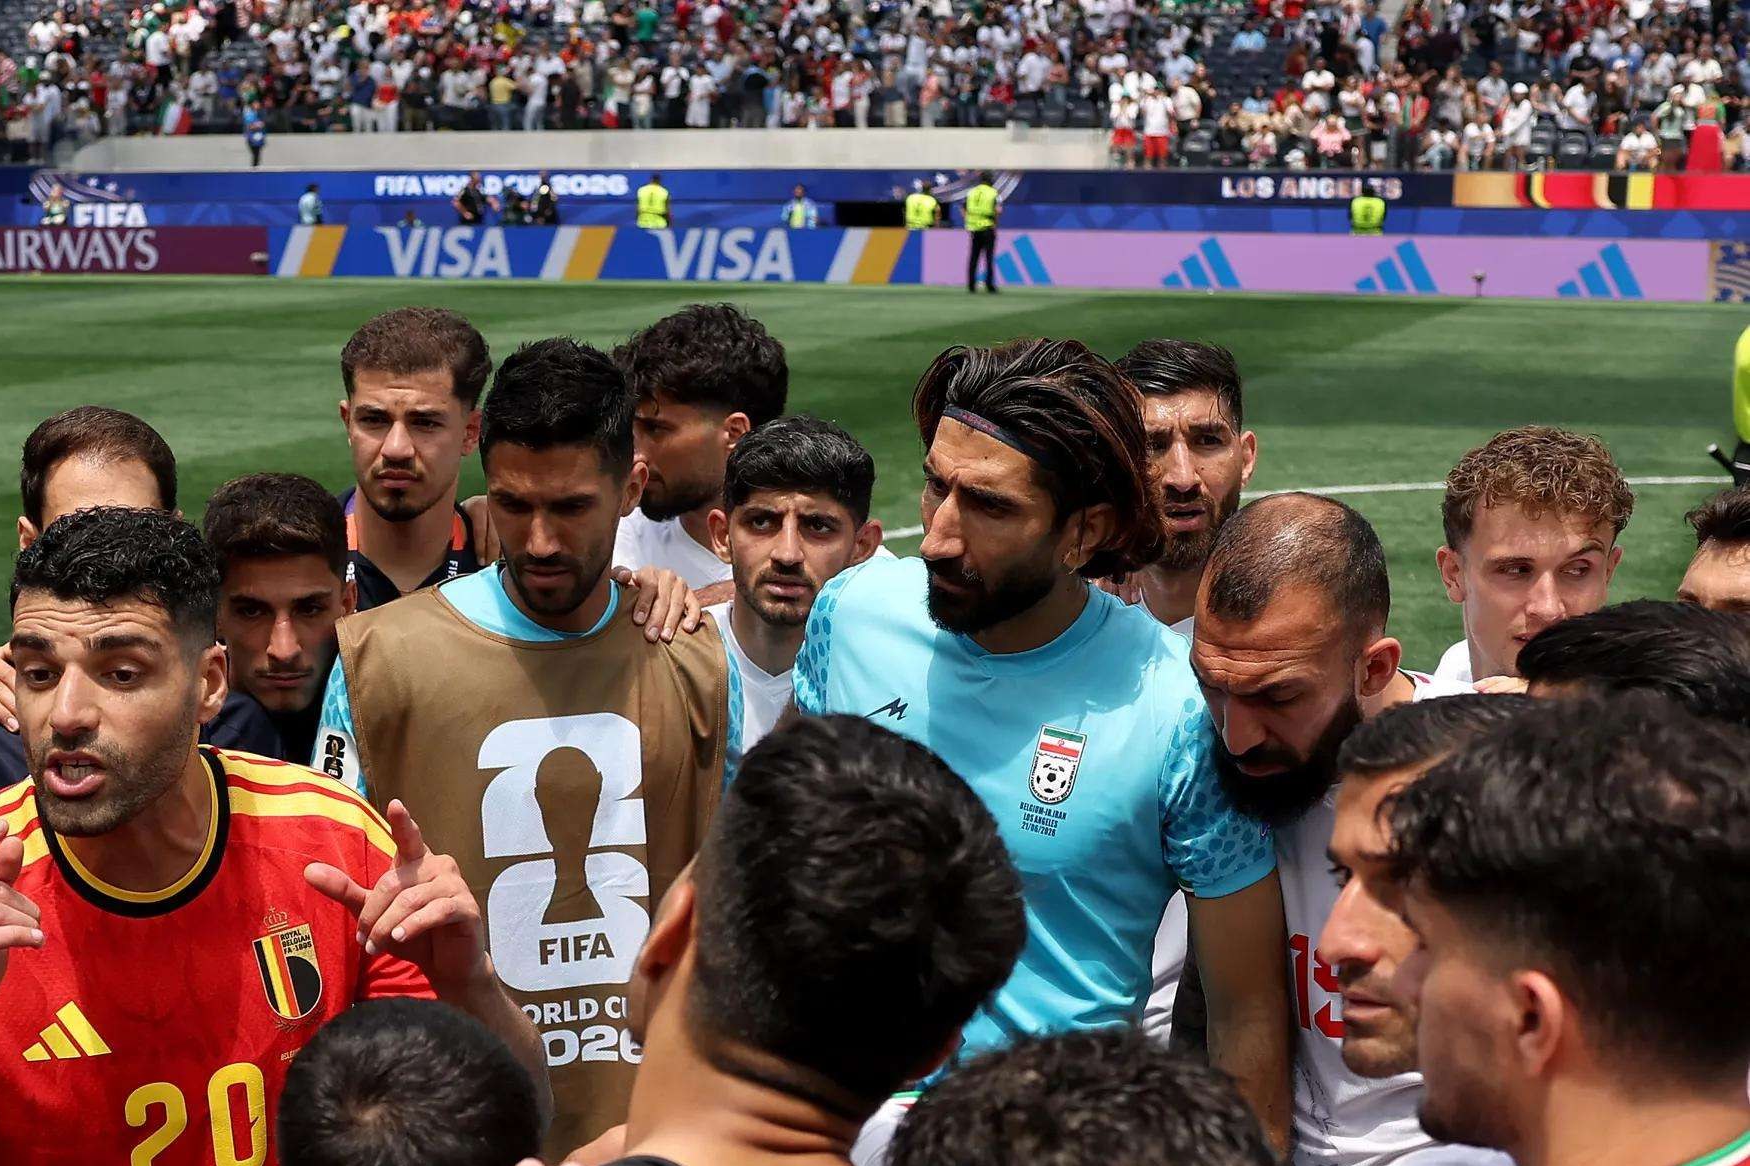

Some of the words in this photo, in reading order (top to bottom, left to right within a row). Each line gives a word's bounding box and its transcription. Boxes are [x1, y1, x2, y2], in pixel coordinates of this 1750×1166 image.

[374, 175, 422, 197] FIFA
[422, 175, 503, 197] WORD
[550, 174, 629, 196] 2026
[1221, 176, 1275, 199] LOS
[73, 202, 148, 228] FIFA
[375, 225, 512, 278] VISA
[651, 228, 795, 281] VISA
[447, 560, 459, 579] FIF
[280, 929, 302, 941] ROYAL
[281, 934, 311, 948] BELGIAN
[539, 932, 615, 966] FIFA
[521, 997, 599, 1025] ORLD
[541, 1024, 645, 1067] 026
